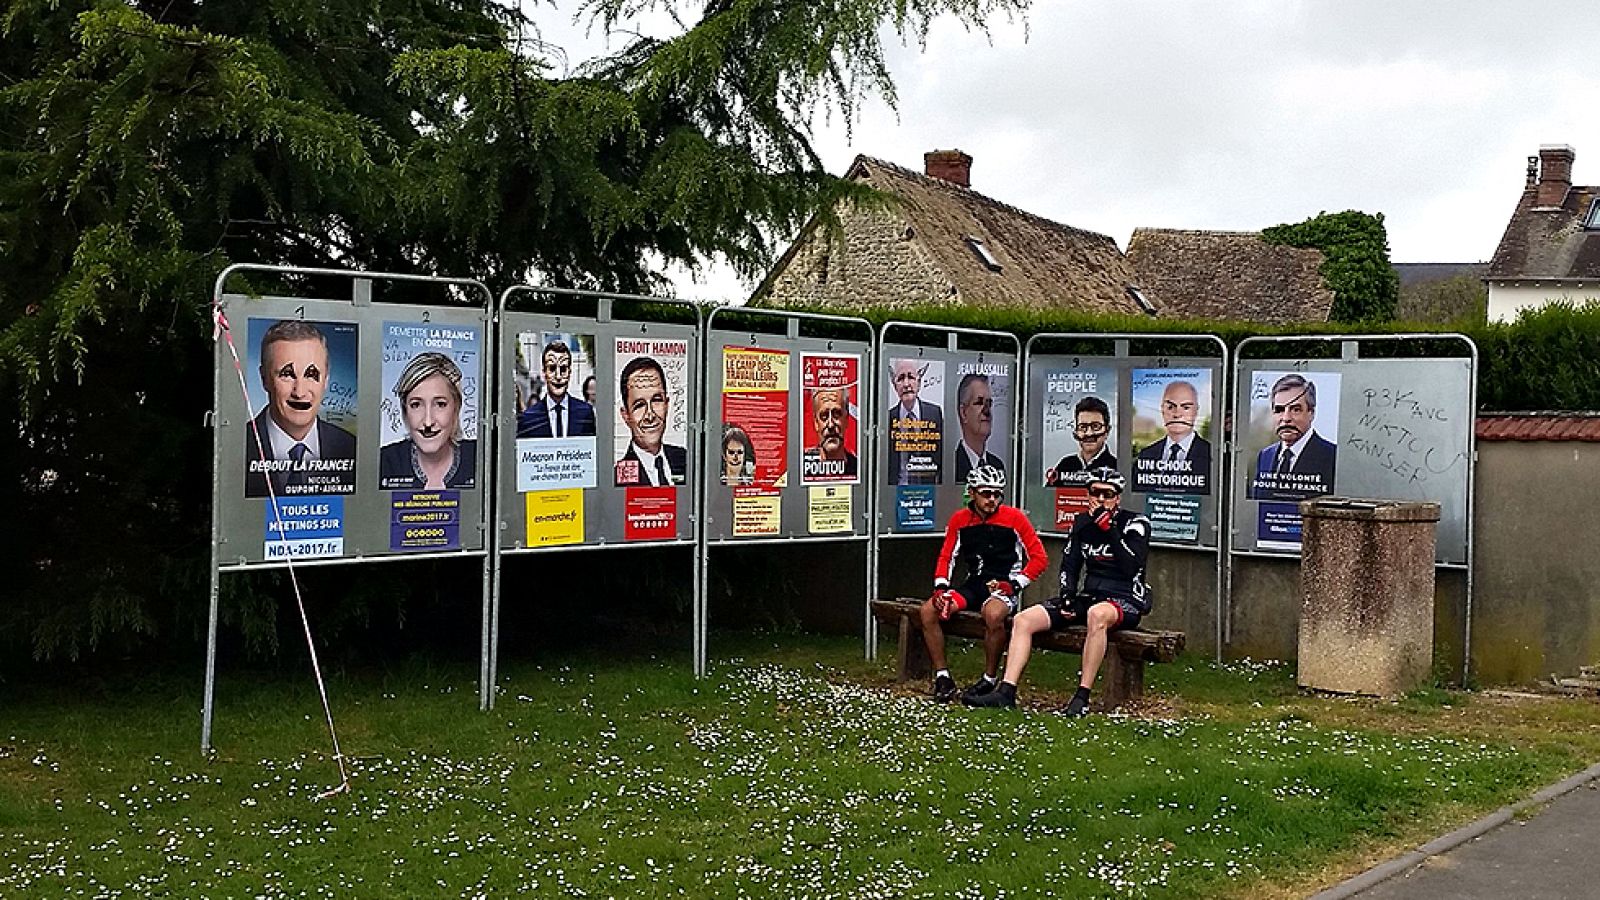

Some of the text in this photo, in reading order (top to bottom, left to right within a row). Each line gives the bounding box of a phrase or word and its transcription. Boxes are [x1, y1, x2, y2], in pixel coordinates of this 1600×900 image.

[294, 305, 304, 320] 1
[422, 310, 431, 324] 2
[555, 316, 561, 329] 3
[430, 329, 442, 338] LA
[442, 329, 475, 341] FRANCE
[750, 334, 757, 345] 5
[652, 342, 687, 356] HAMON
[827, 341, 833, 351] 6
[726, 360, 735, 369] LE
[736, 360, 757, 370] CAMP
[1072, 357, 1080, 368] 9
[956, 362, 1008, 377] JEAN LASSALLE
[1047, 381, 1097, 393] PEUPLE
[521, 448, 592, 463] Macron Président
[293, 460, 307, 472] LA
[804, 460, 846, 475] POUTOU
[1137, 459, 1193, 472] UN CHOIX
[308, 476, 341, 485] NICOLAS
[1137, 473, 1206, 488] HISTORIQUE
[1259, 472, 1278, 480] UNE
[1253, 480, 1278, 489] POUR
[1292, 483, 1329, 493] FRANCE
[281, 505, 329, 518] TOUS LES
[319, 519, 340, 530] SUR
